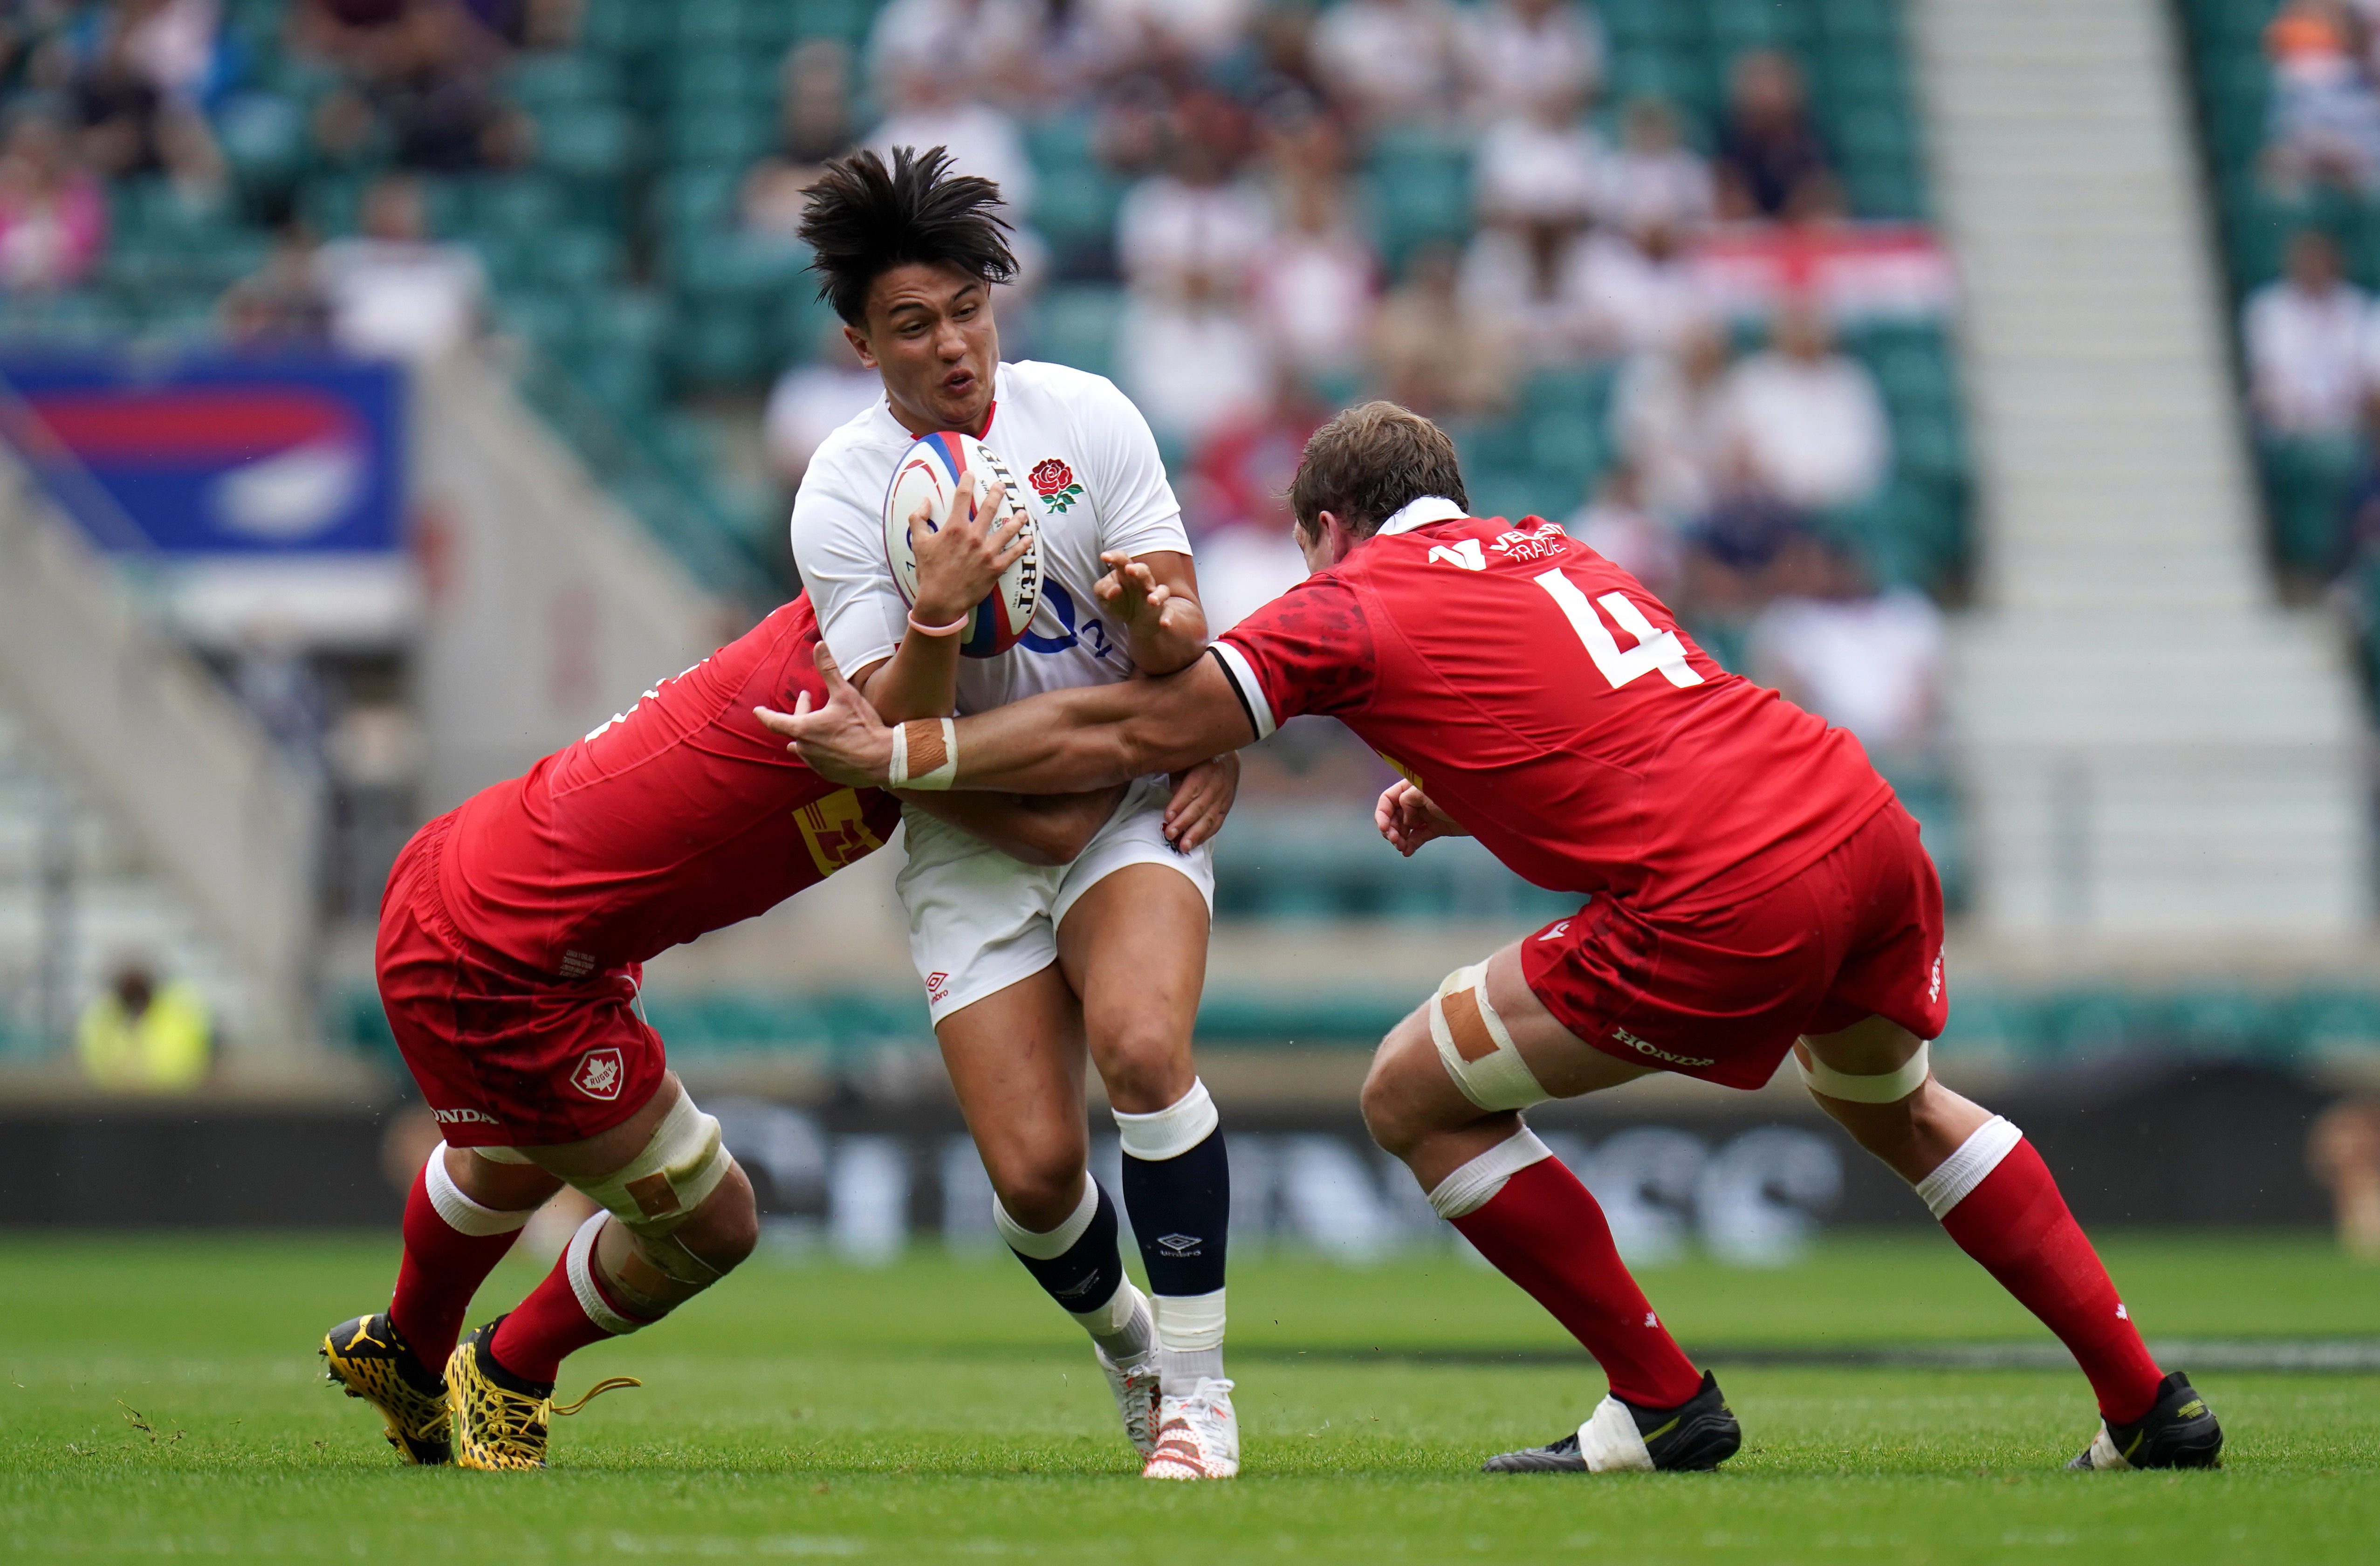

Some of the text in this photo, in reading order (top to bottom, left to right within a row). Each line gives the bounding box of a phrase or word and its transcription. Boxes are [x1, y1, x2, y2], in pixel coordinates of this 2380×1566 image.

[1503, 537, 1567, 562] TRADE
[1534, 567, 1705, 689] 4
[1612, 1027, 1715, 1066] HONDA
[590, 1066, 613, 1086] RUGBY
